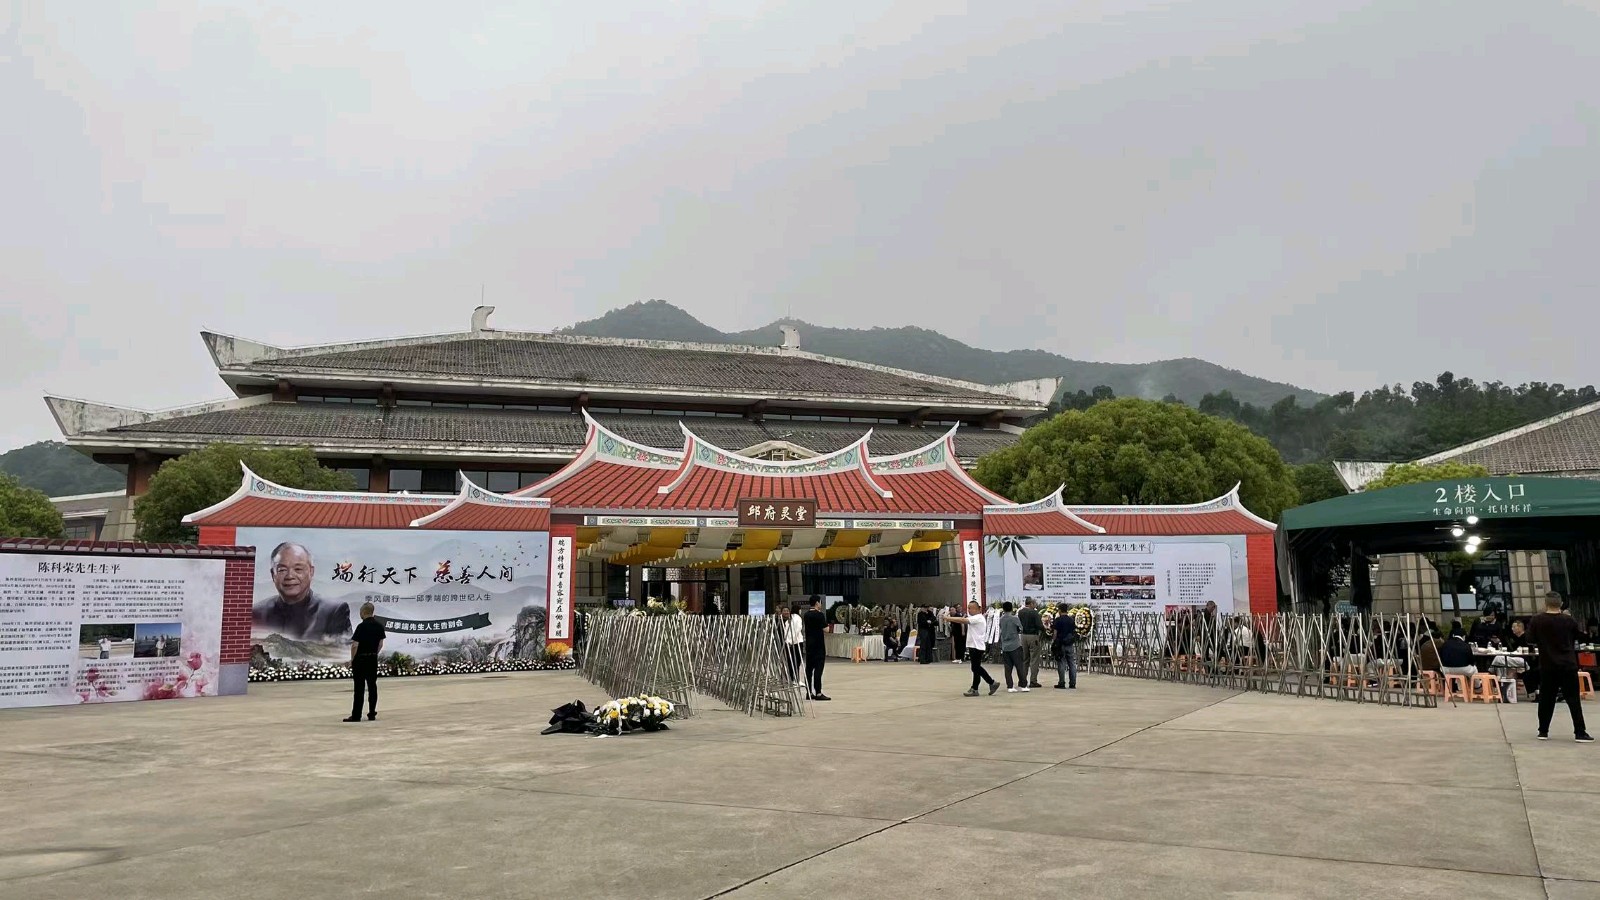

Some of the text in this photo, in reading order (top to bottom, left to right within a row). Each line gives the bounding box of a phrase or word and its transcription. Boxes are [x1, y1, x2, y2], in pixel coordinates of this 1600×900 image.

[1435, 483, 1525, 504] 2楼入口
[747, 504, 808, 522] 邱府灵堂
[1088, 542, 1147, 552] 邱季端先生生平
[38, 561, 121, 575] 陈科荣先生生平
[331, 559, 514, 585] 端行天下 慈善人间
[385, 619, 464, 631] 邱季端先生人生告别会
